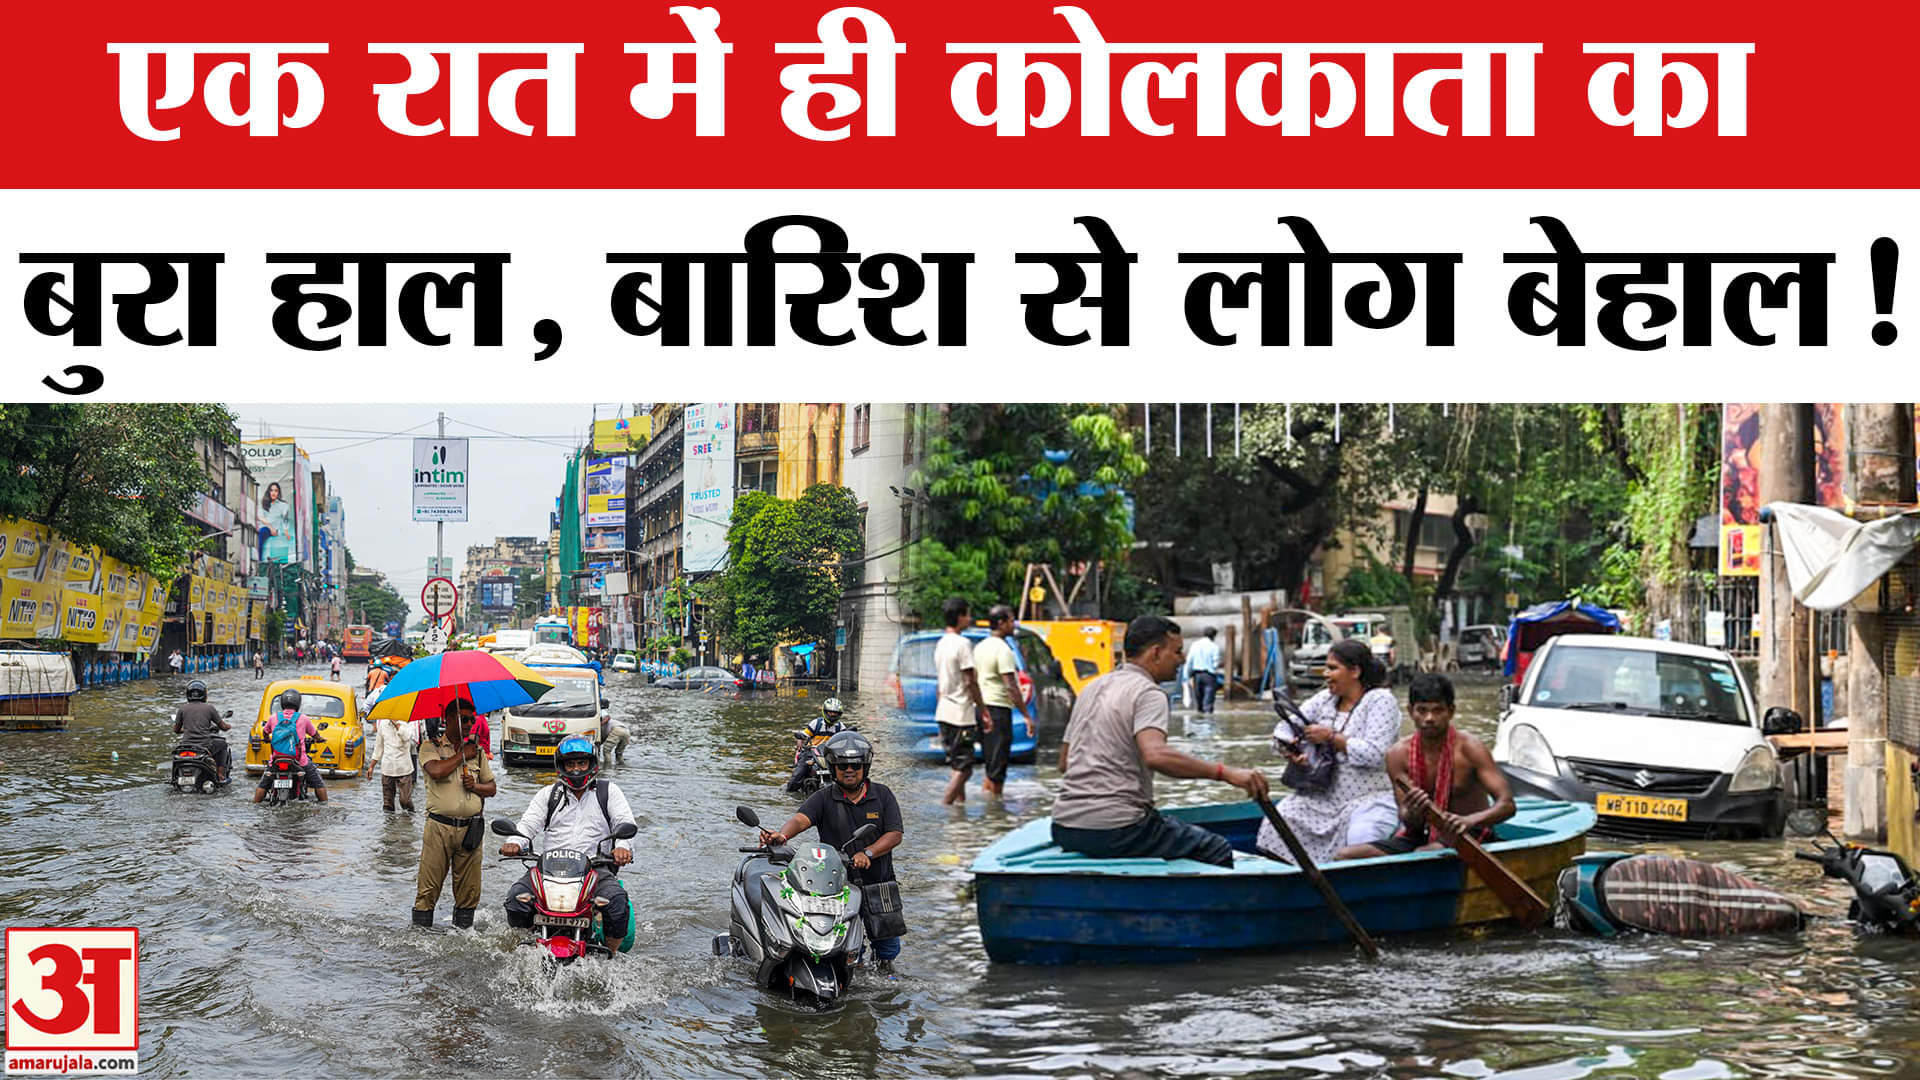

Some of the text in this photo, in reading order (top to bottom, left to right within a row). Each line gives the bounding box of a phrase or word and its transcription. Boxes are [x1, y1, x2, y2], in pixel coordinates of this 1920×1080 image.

[692, 442, 712, 456] SREE
[414, 467, 464, 483] intim
[690, 488, 721, 501] TRUSTED
[76, 598, 88, 607] LUX
[432, 634, 438, 642] 2
[545, 850, 582, 861] POLICE
